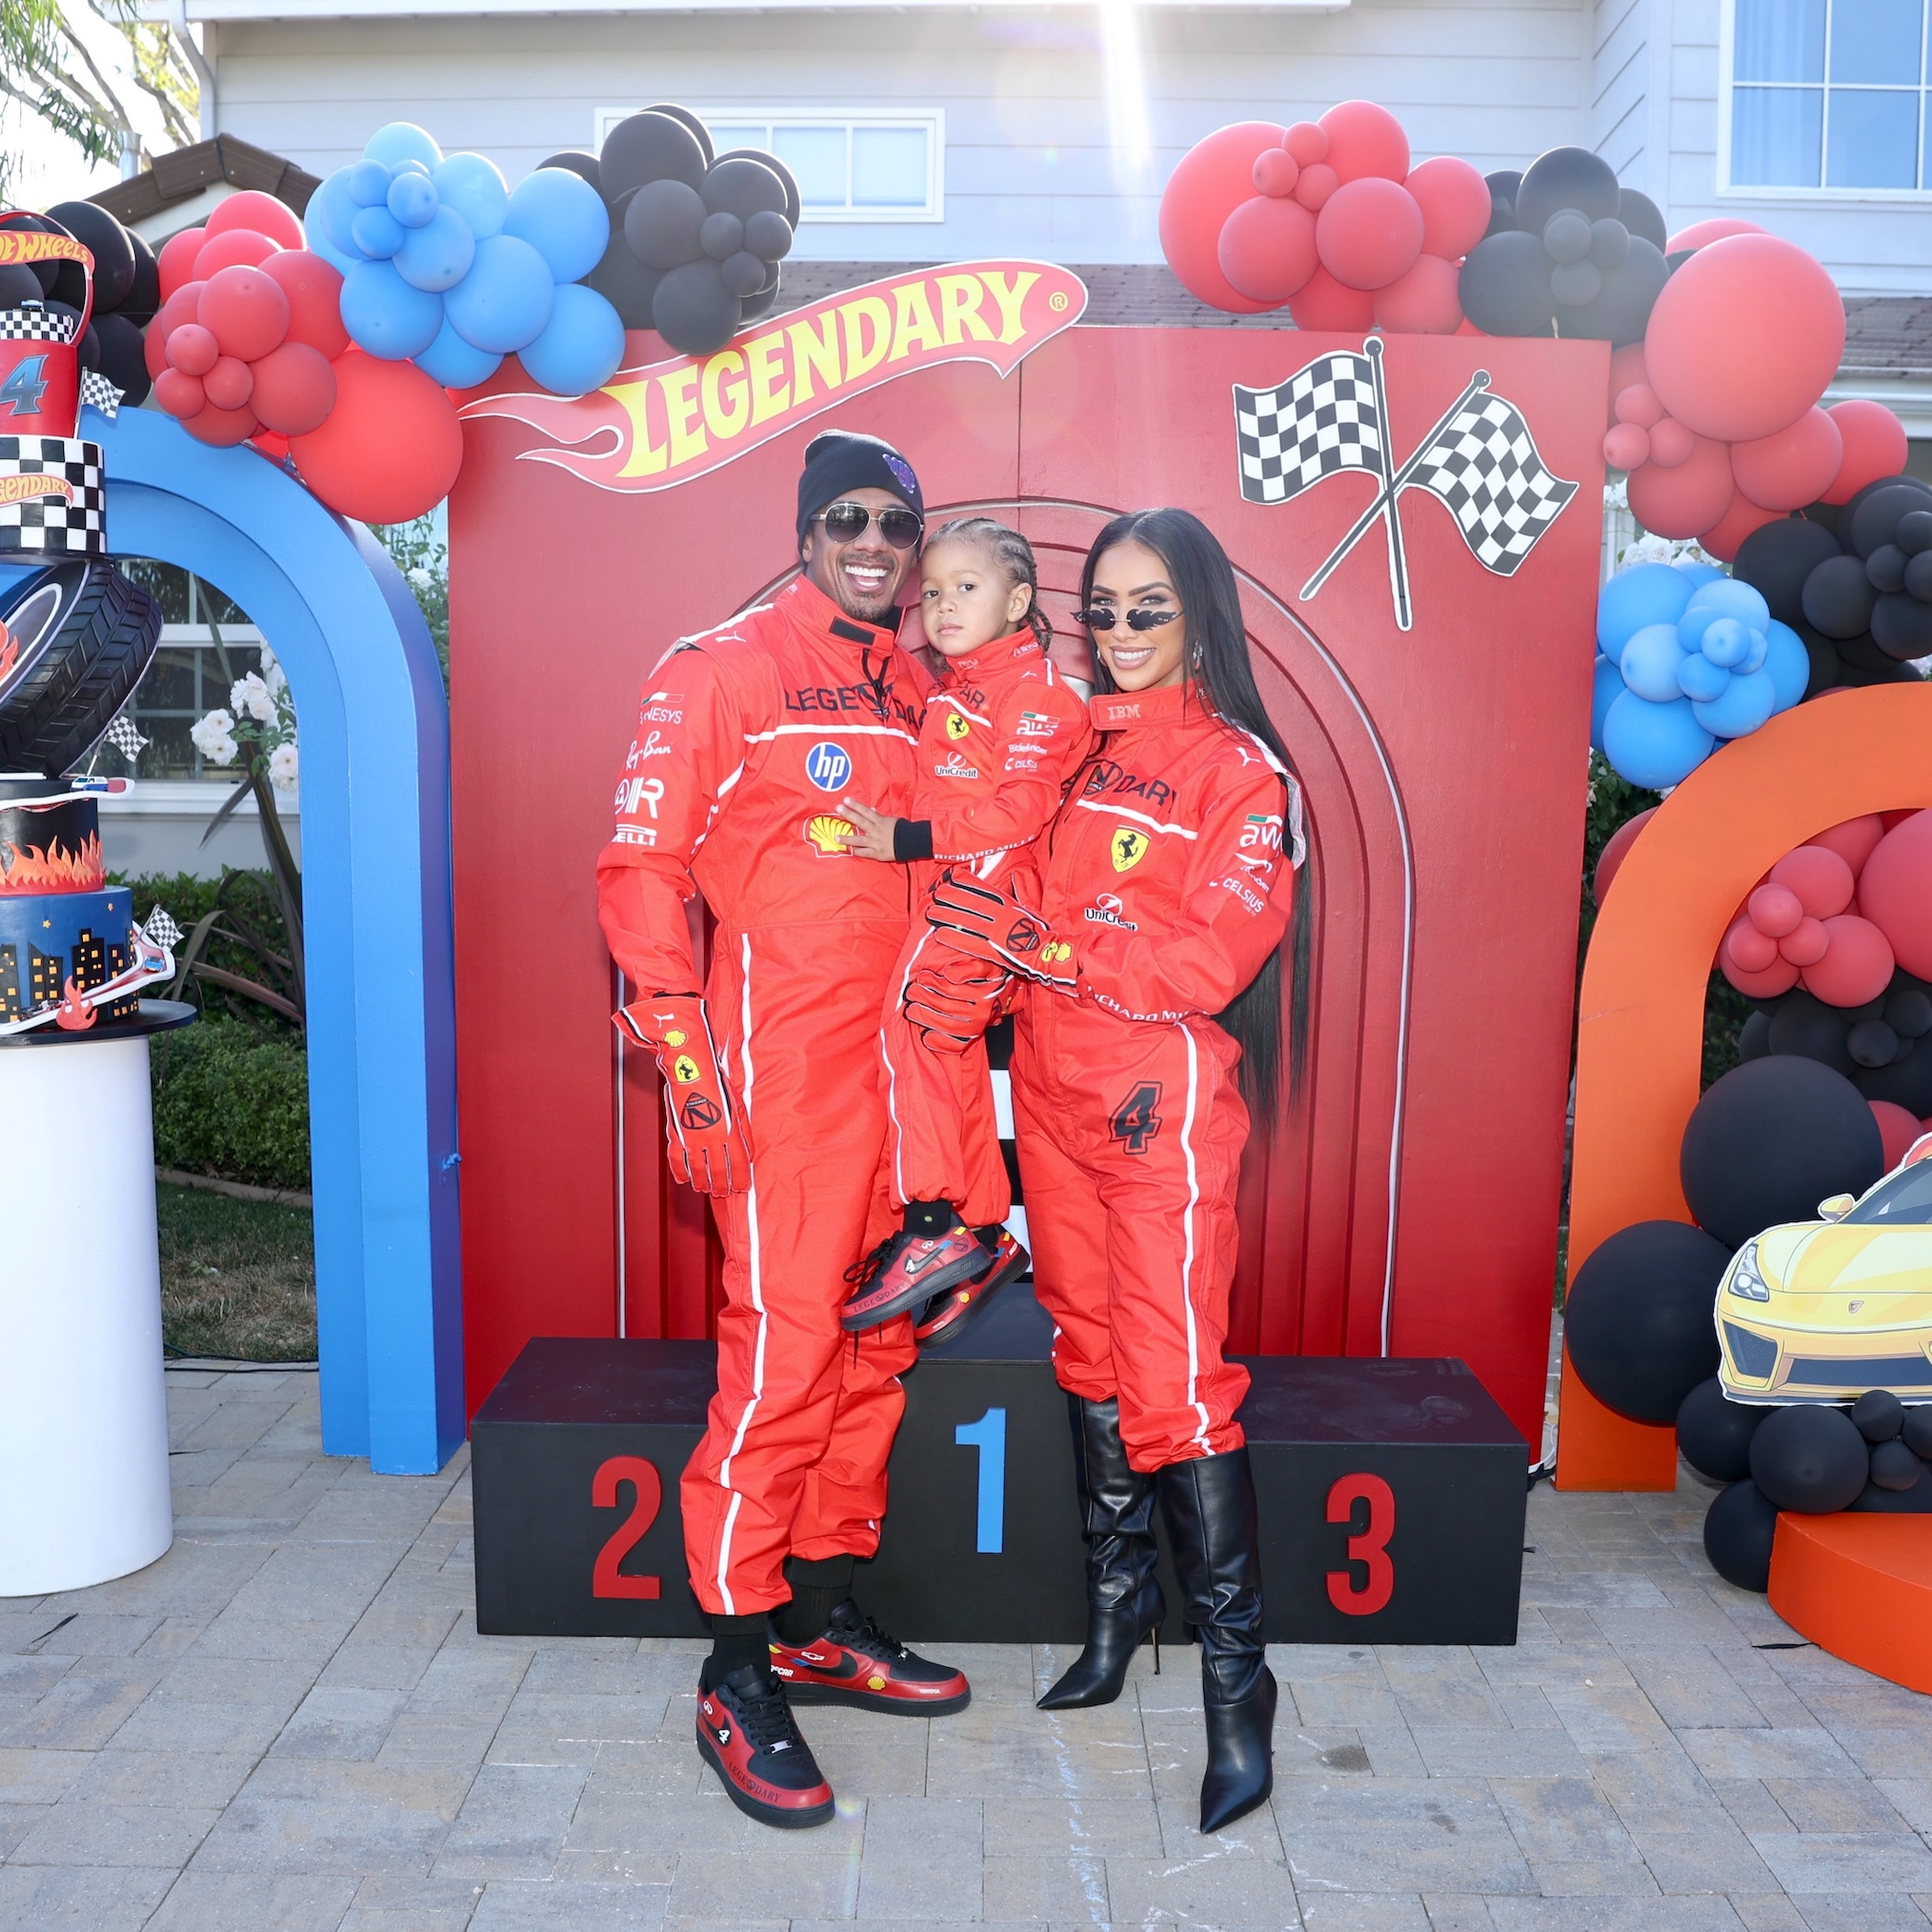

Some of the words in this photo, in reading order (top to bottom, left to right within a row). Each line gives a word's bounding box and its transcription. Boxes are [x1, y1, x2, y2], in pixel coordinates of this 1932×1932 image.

[0, 353, 50, 416] 4
[598, 272, 1042, 477] LEGENDARY
[1107, 704, 1141, 720] IBM
[814, 741, 846, 792] hp
[936, 766, 976, 777] UniCredit
[934, 848, 995, 862] RICHARD
[996, 834, 1036, 853] MILLE
[1239, 824, 1283, 851] aw
[1222, 877, 1265, 914] CELSIUS
[1108, 1080, 1163, 1155] 4
[905, 1258, 916, 1273] 4
[955, 1407, 1007, 1554] 1
[592, 1455, 663, 1600] 2
[1325, 1472, 1397, 1617] 3
